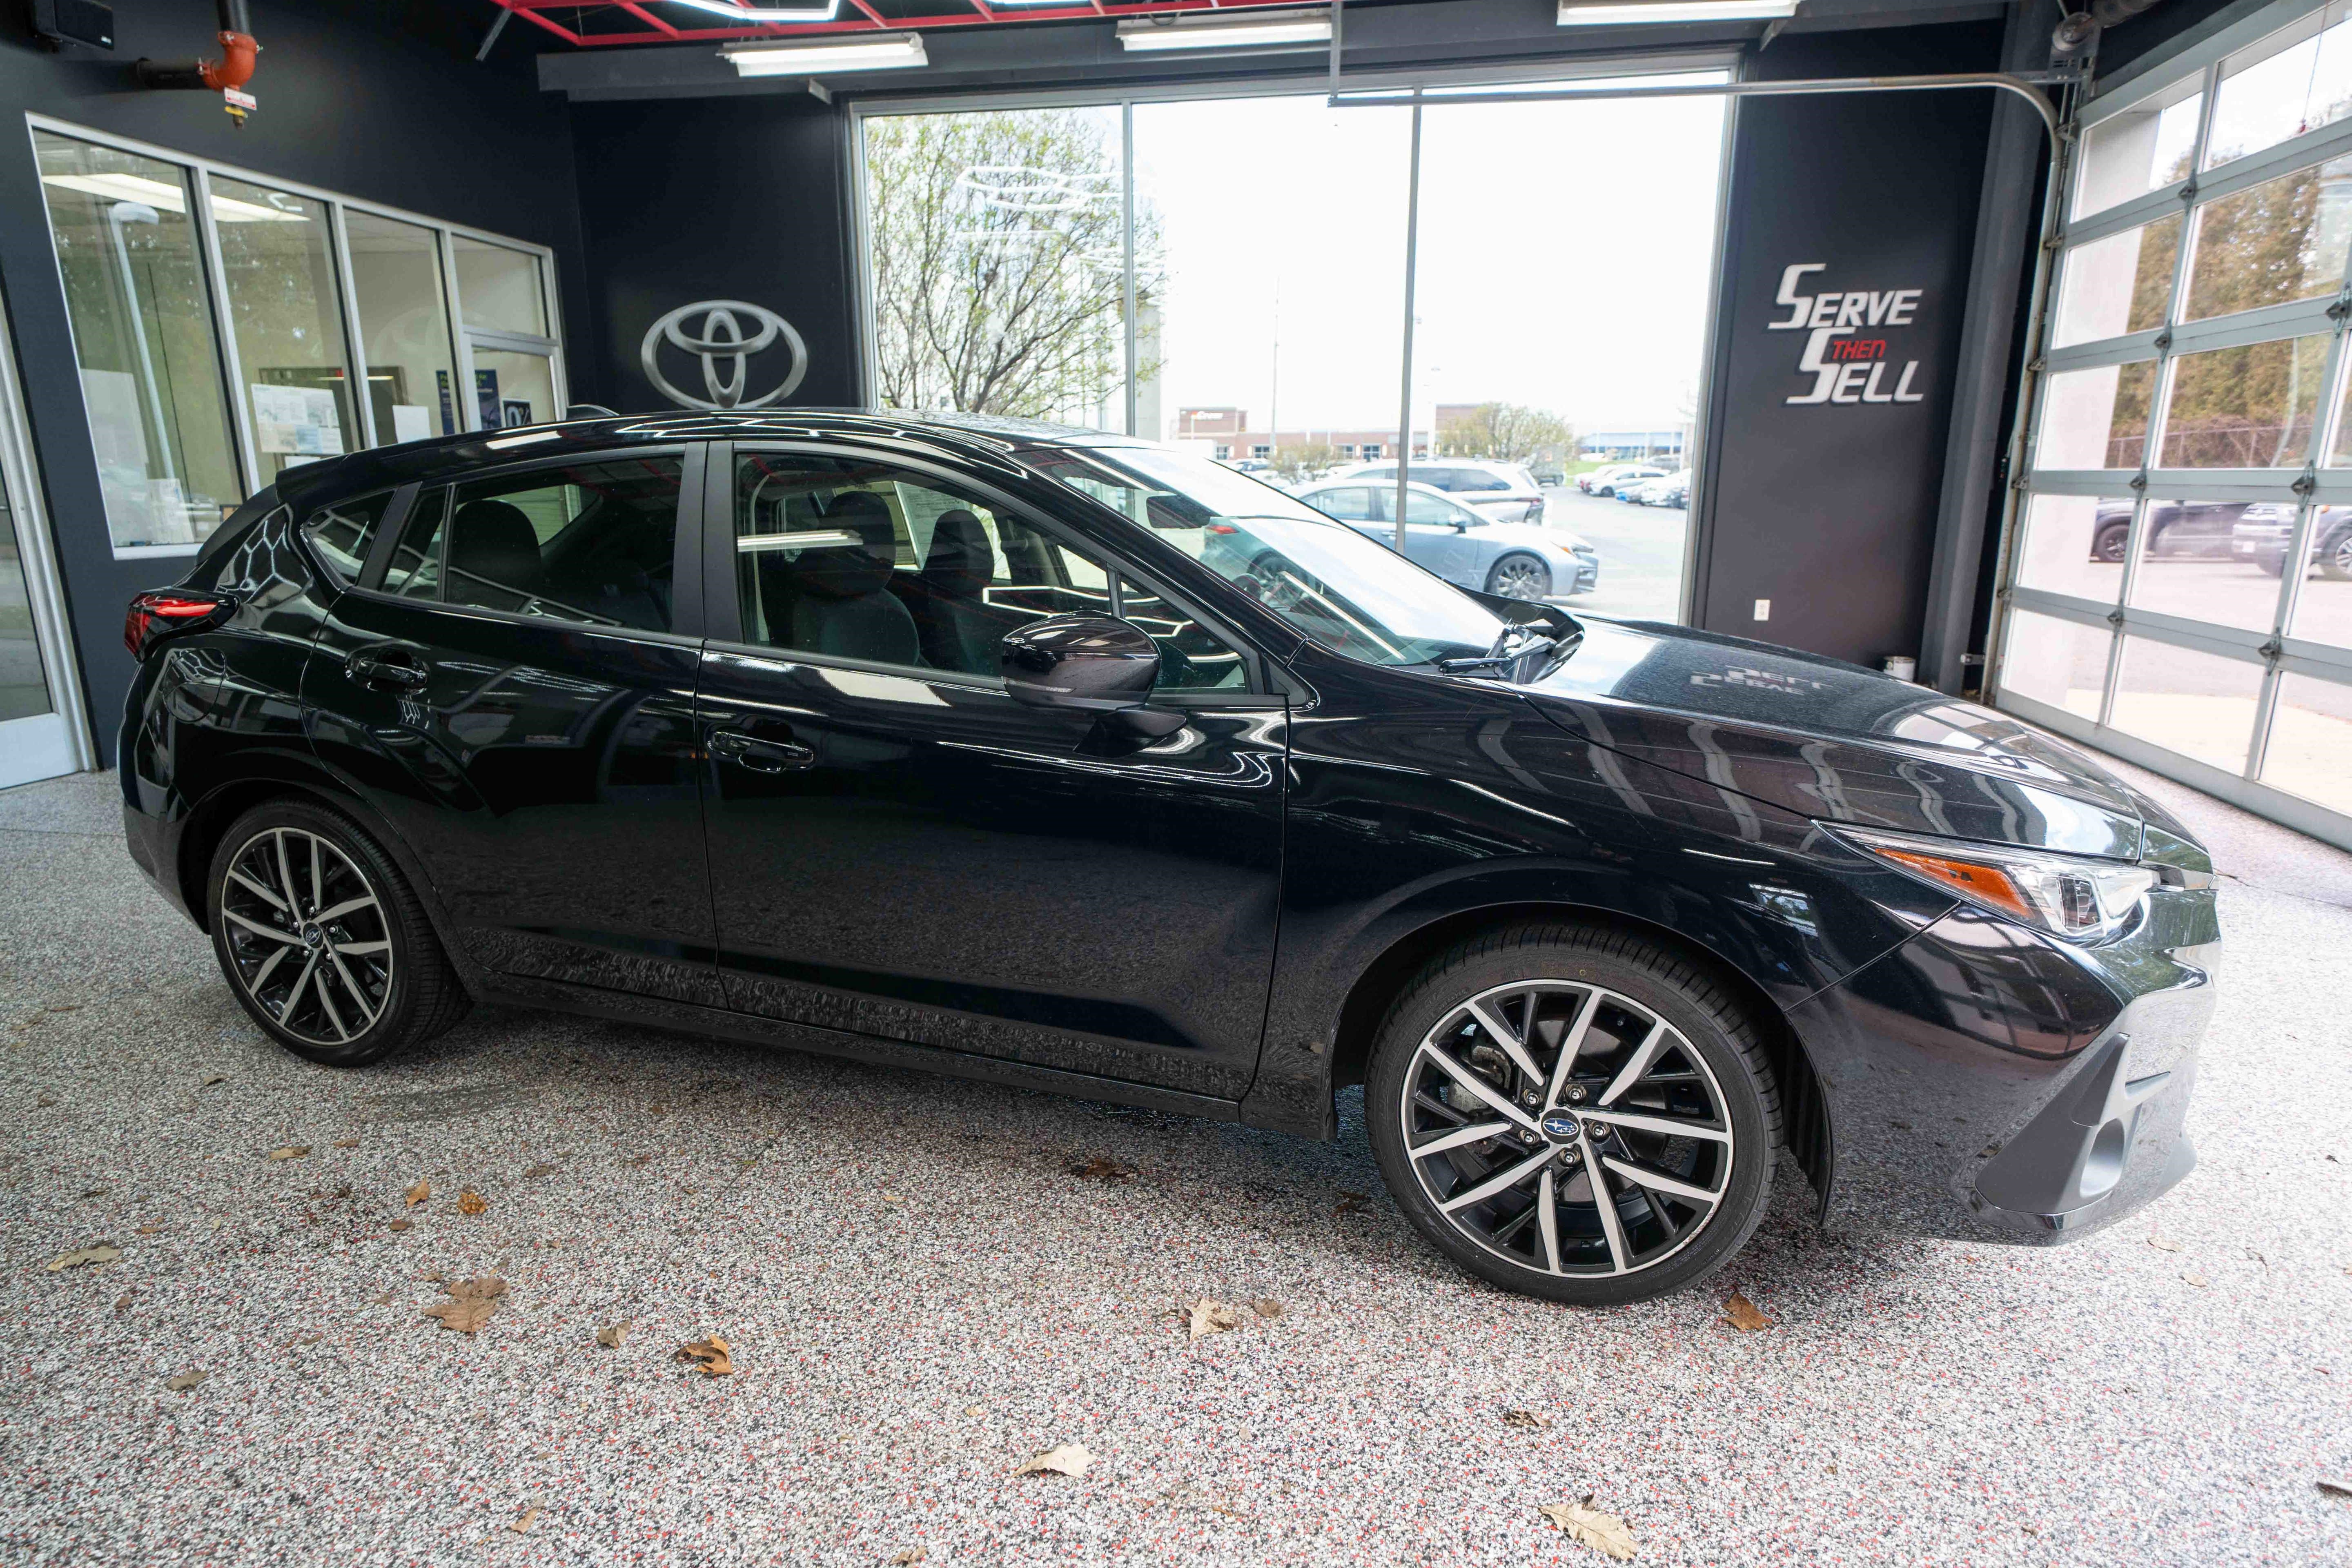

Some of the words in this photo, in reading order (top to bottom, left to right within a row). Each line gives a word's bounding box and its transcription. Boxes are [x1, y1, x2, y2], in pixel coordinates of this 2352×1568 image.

[1767, 263, 1923, 329] SERVE
[1786, 326, 1924, 404] SELL
[1833, 339, 1886, 359] THEN
